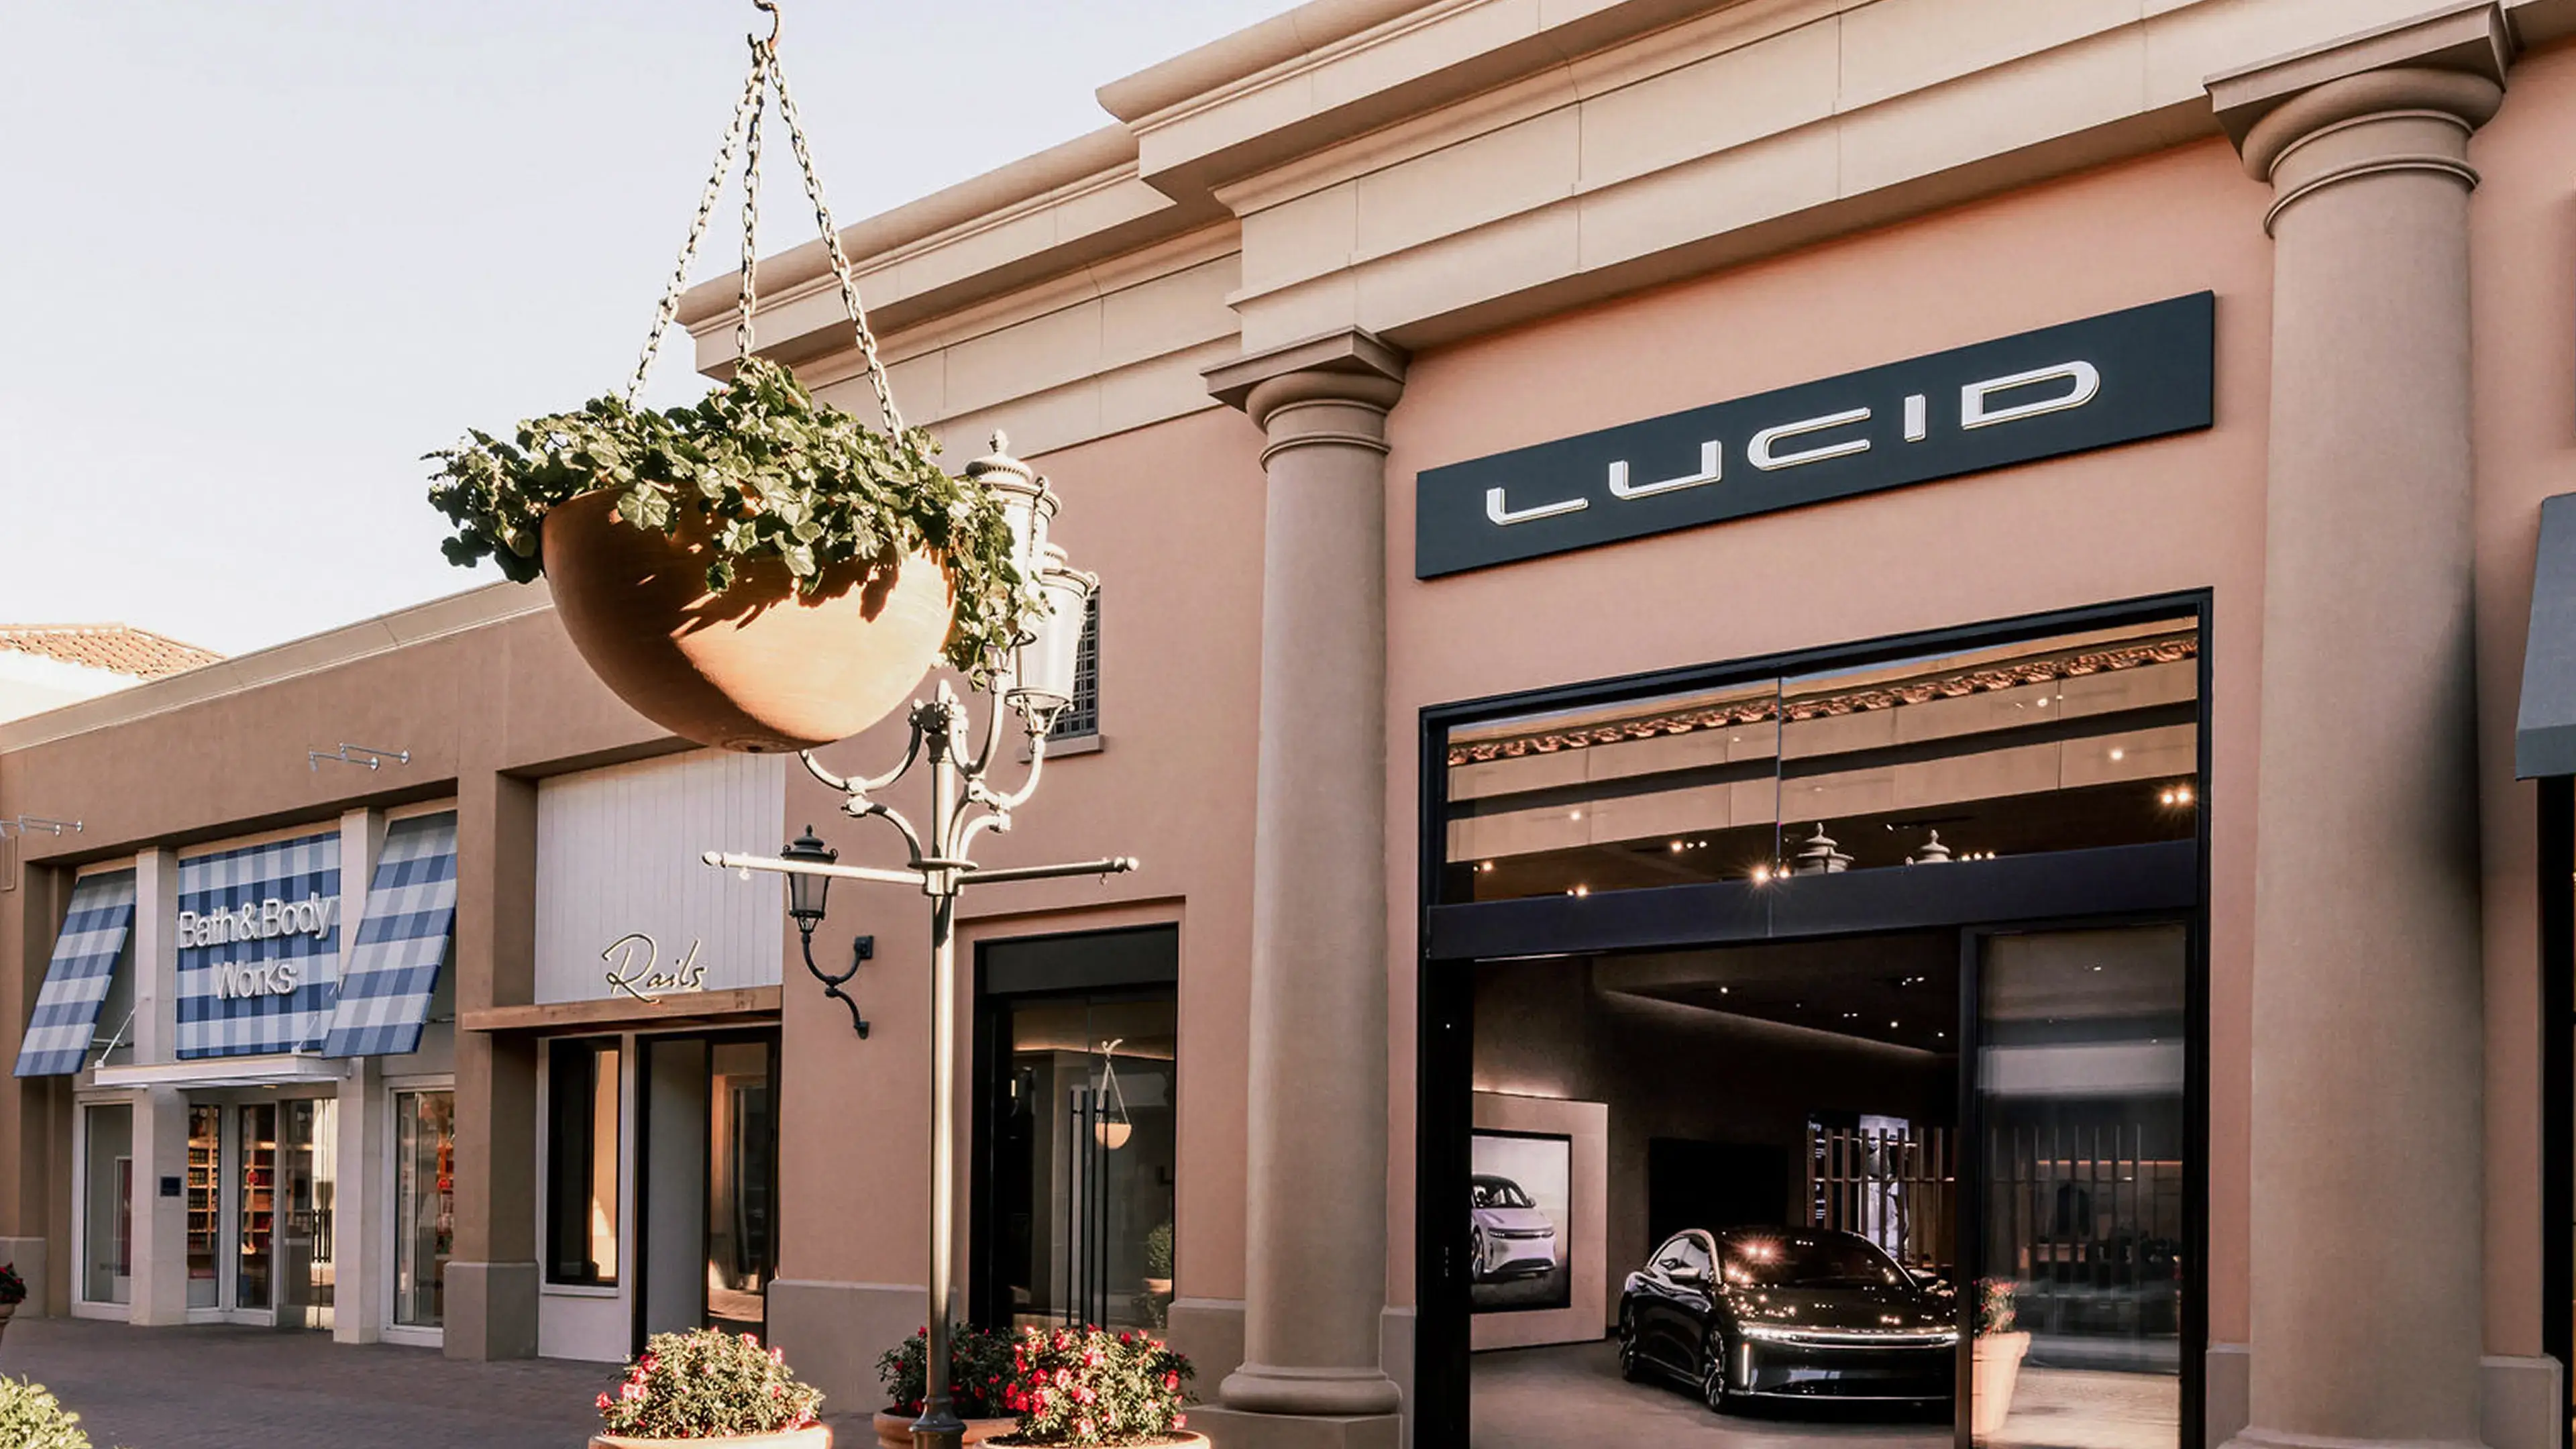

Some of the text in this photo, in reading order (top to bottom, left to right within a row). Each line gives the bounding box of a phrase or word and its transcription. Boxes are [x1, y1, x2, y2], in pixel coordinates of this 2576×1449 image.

[1486, 360, 2100, 526] LUCID
[213, 957, 297, 998] Works
[602, 933, 706, 1004] Rails
